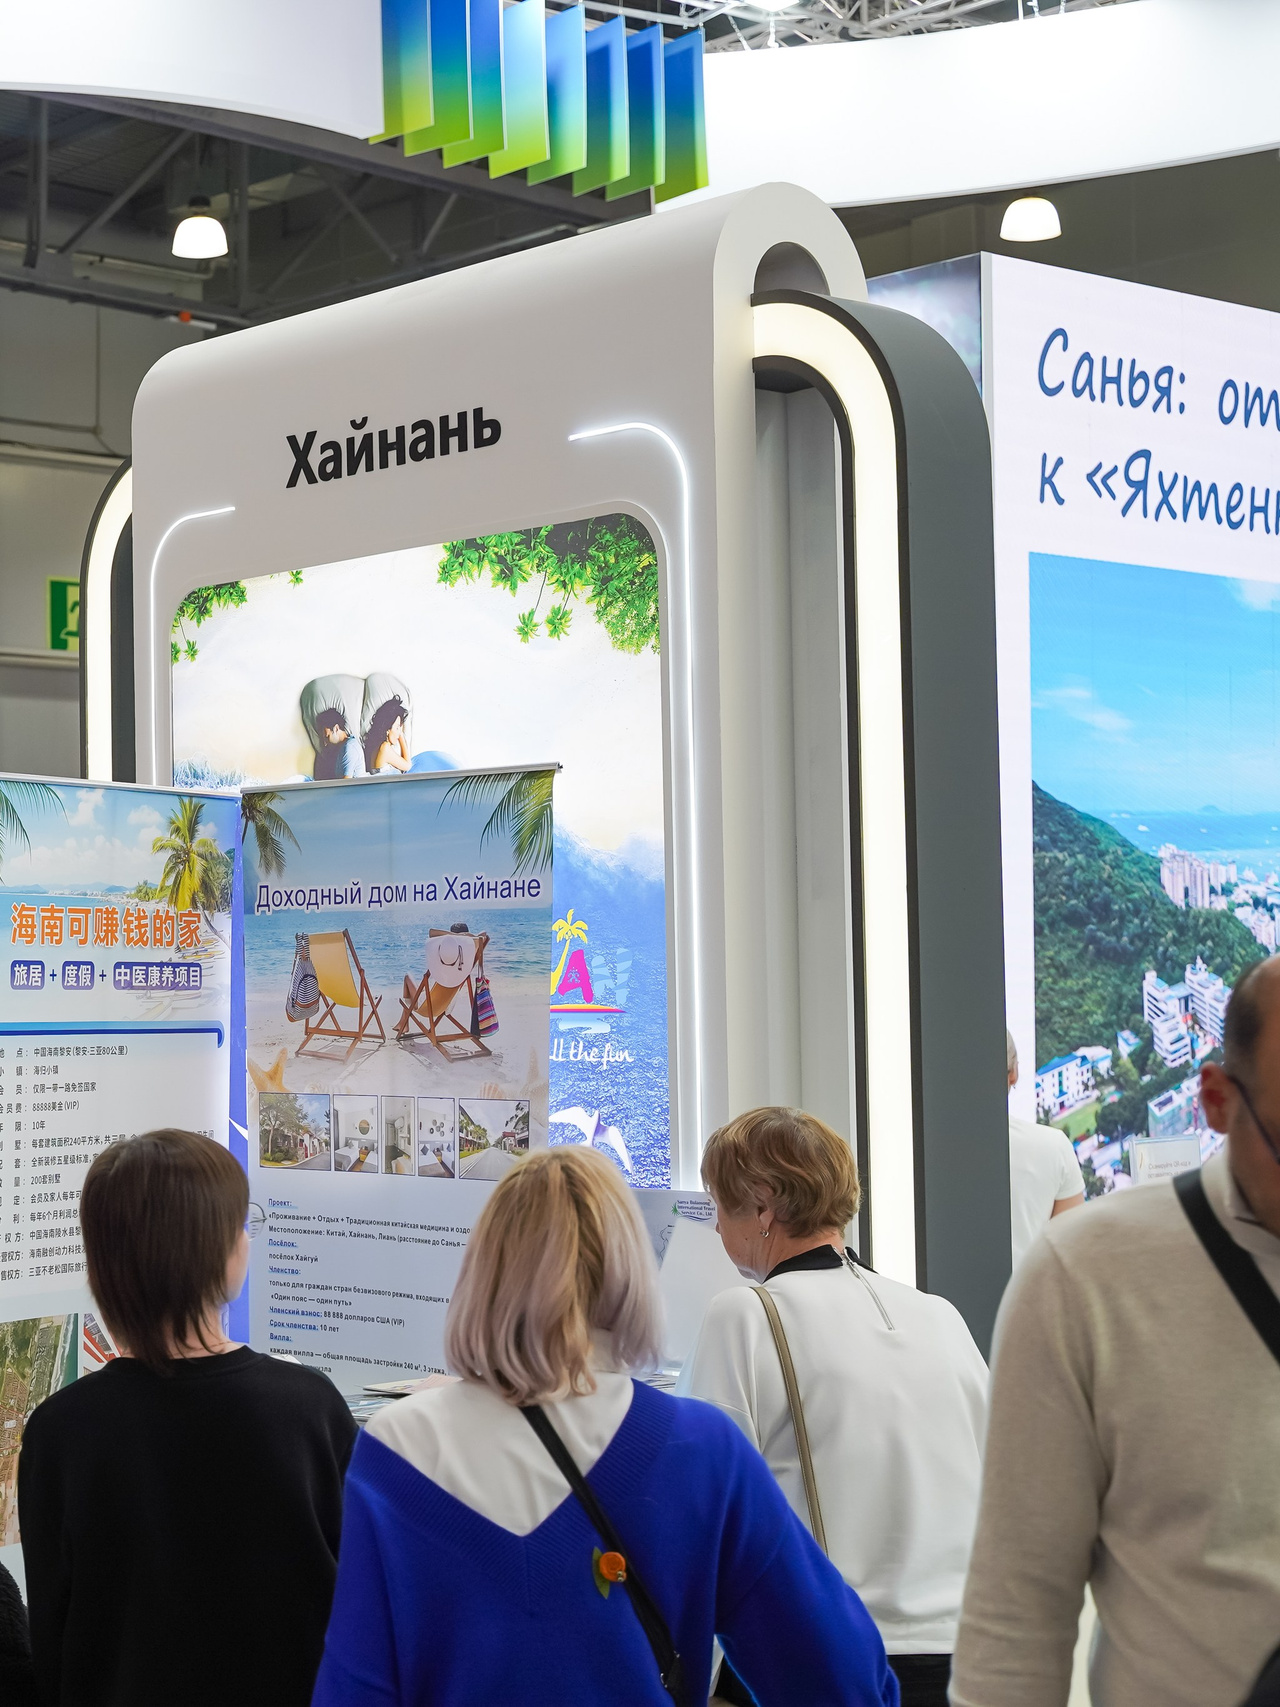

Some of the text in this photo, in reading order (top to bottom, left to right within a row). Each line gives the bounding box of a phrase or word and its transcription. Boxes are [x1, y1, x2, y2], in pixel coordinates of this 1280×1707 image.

[1038, 327, 1186, 415] Санья:
[285, 406, 502, 489] Хайнань
[1039, 452, 1065, 506] к
[256, 875, 542, 913] Доходный дом на Хайнане
[10, 902, 203, 948] 海南可赚钱的家
[13, 964, 42, 987] 旅居
[64, 964, 91, 987] 度假
[114, 964, 202, 987] 中医康养项目
[549, 1038, 635, 1071] ll the fun
[32, 1120, 46, 1130] 10年
[29, 1208, 81, 1222] 每年6个月利润总
[268, 1198, 293, 1207] Проект:
[455, 1227, 472, 1235] оздо
